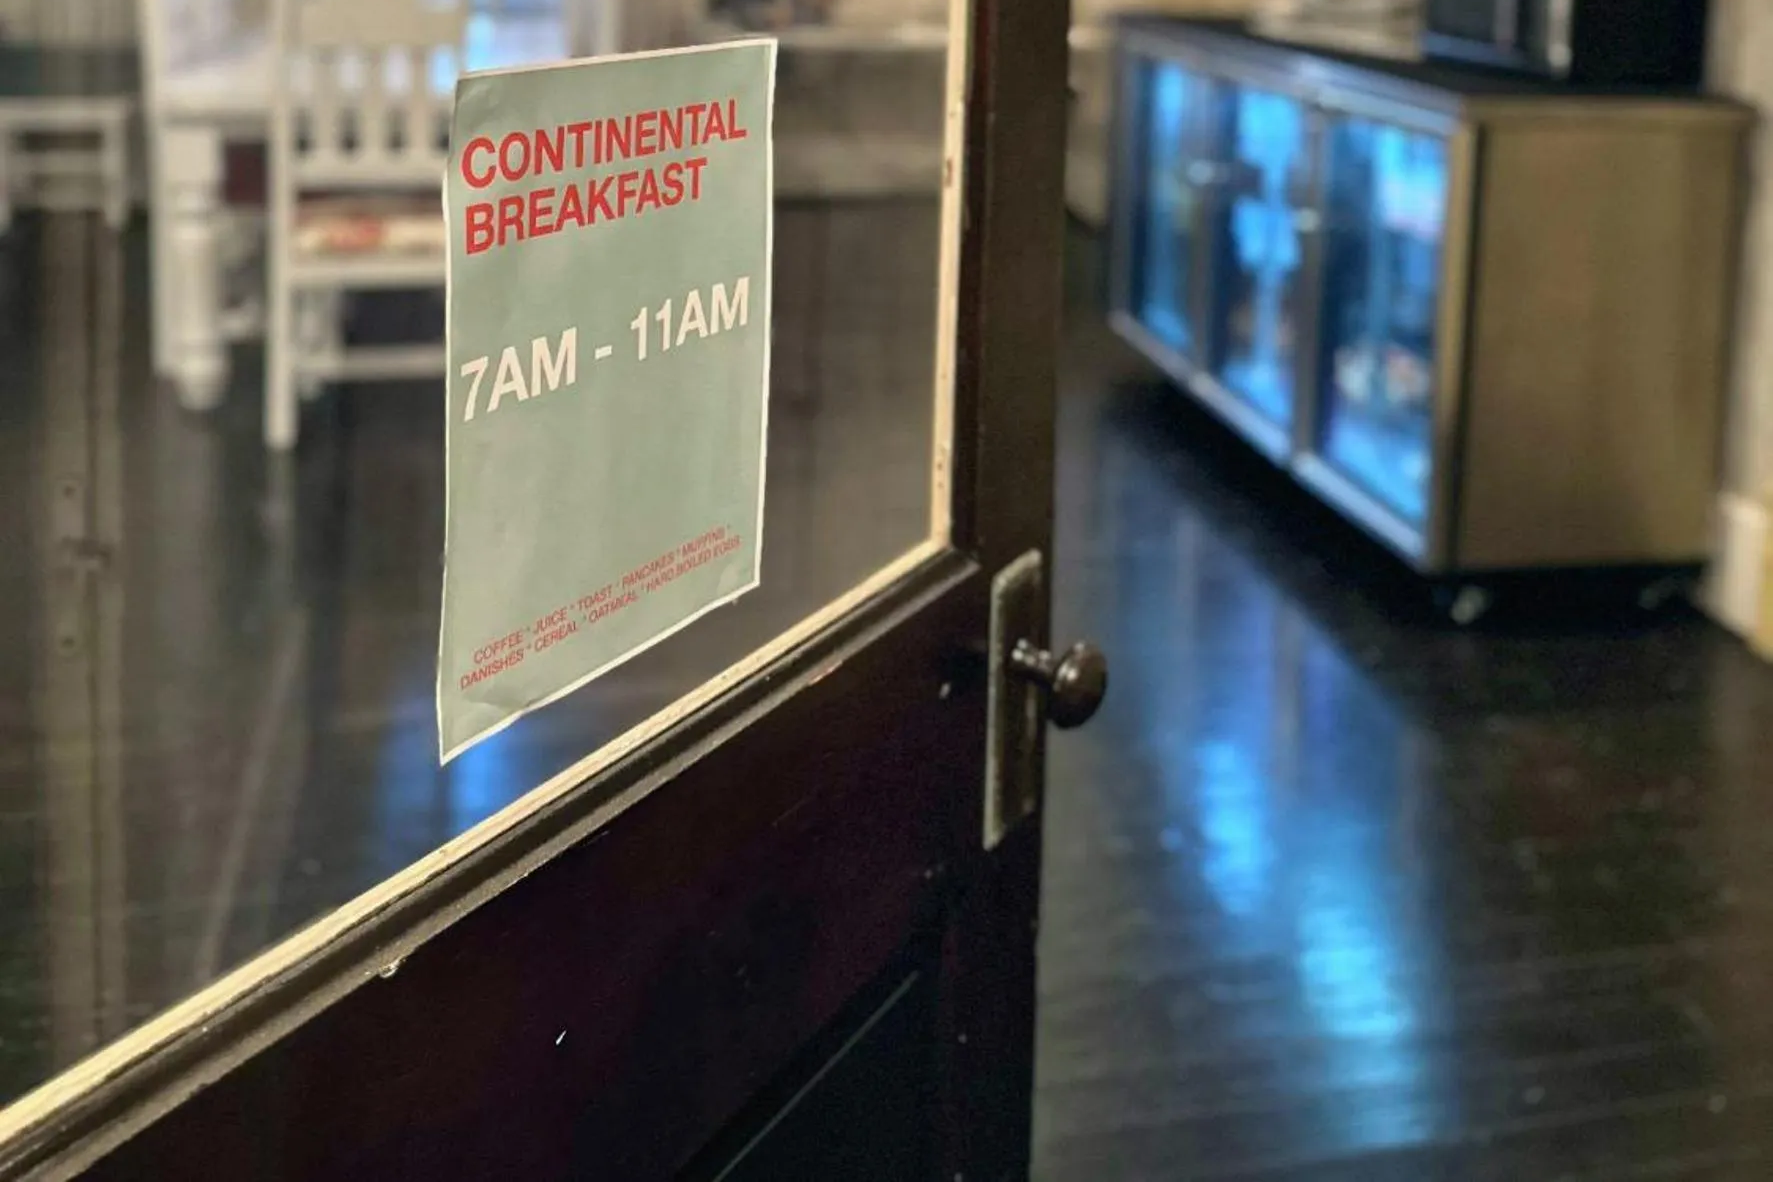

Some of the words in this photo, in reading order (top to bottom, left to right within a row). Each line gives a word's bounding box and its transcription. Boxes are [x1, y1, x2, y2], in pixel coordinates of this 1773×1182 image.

[461, 99, 748, 189] CONTINENTAL
[465, 158, 708, 255] BREAKFAST
[461, 327, 577, 422] 7AM
[631, 276, 750, 361] 11AM
[460, 647, 524, 690] DANISHES
[534, 620, 577, 652] CEREAL
[588, 590, 638, 623] OATMEAL
[645, 567, 675, 593] HARD
[473, 630, 523, 664] COFFEE
[532, 606, 567, 634] JUICE
[577, 584, 612, 611] TOAST
[622, 551, 675, 590] PANCAKES
